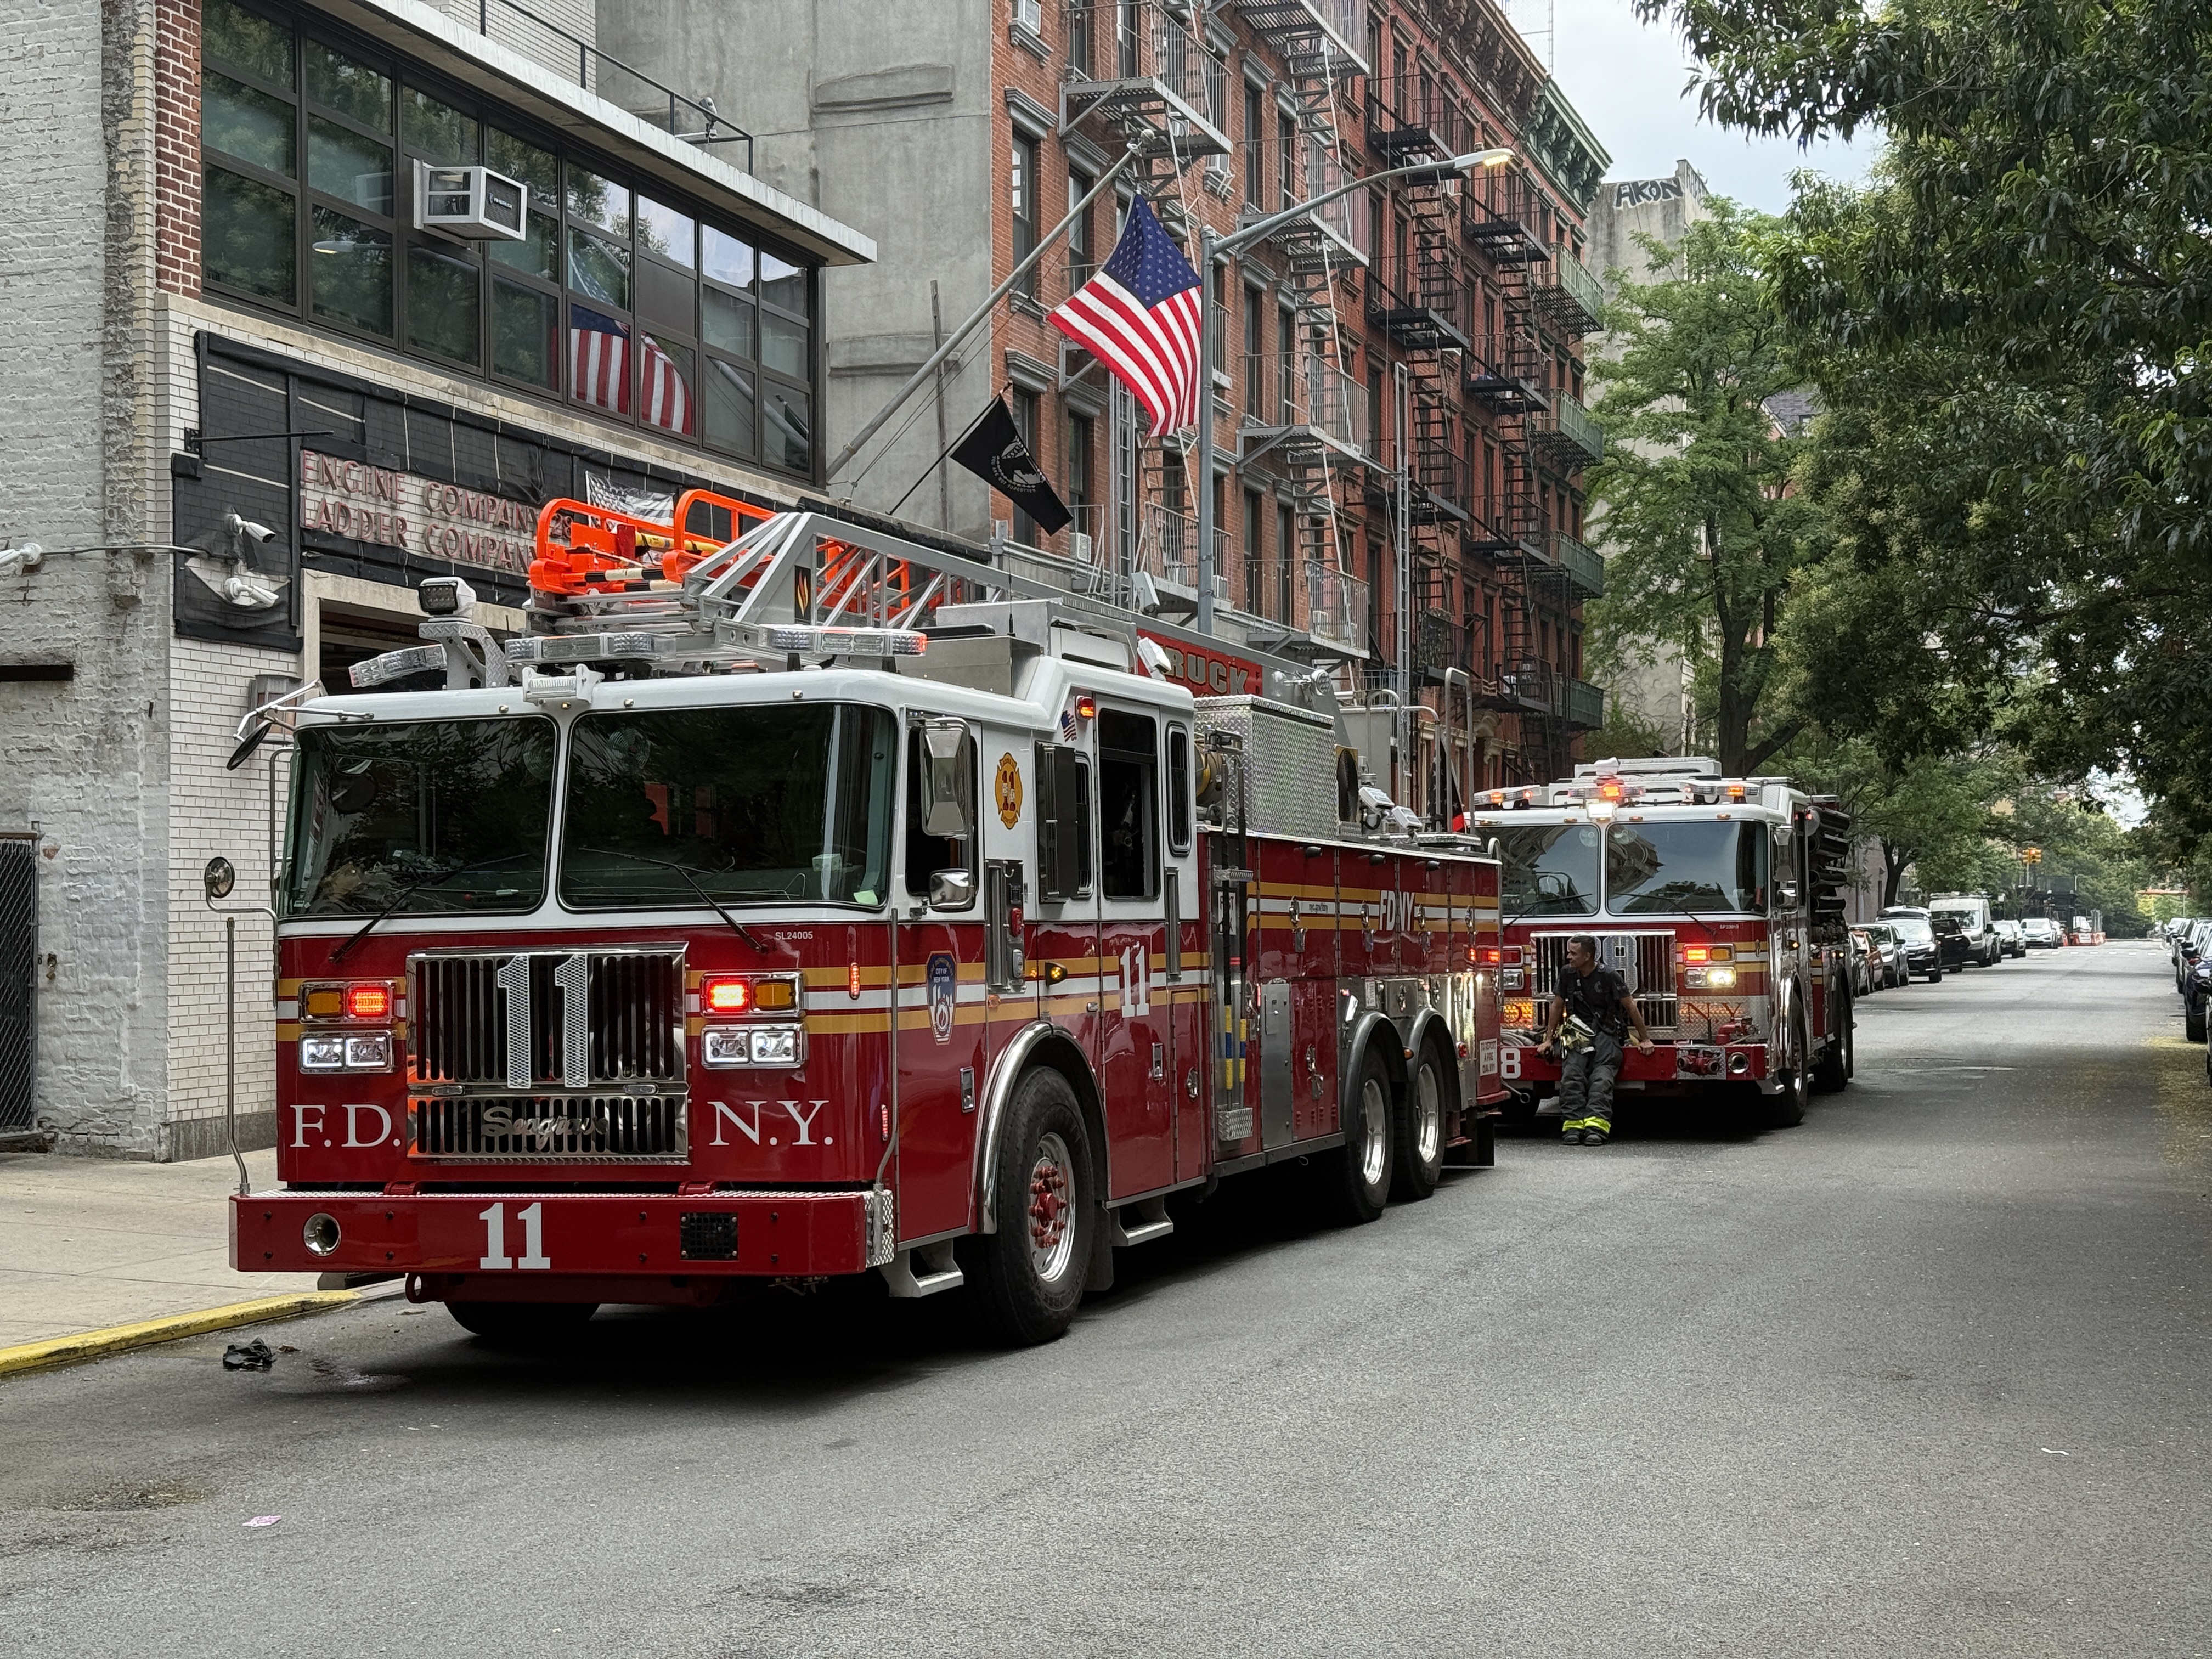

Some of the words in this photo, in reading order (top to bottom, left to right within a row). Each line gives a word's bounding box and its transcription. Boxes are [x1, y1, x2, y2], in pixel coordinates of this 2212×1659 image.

[1613, 178, 1684, 210] AKON
[301, 450, 407, 505] ENGINE
[300, 495, 409, 548] LADDER
[1161, 645, 1249, 695] RUCK
[775, 931, 814, 940] SL24005
[1379, 890, 1415, 932] FDNY
[1120, 945, 1150, 1018] 11
[497, 953, 588, 1090] 11
[290, 1104, 400, 1147] F.D.
[707, 1100, 833, 1146] N.Y.
[479, 1201, 550, 1269] 11
